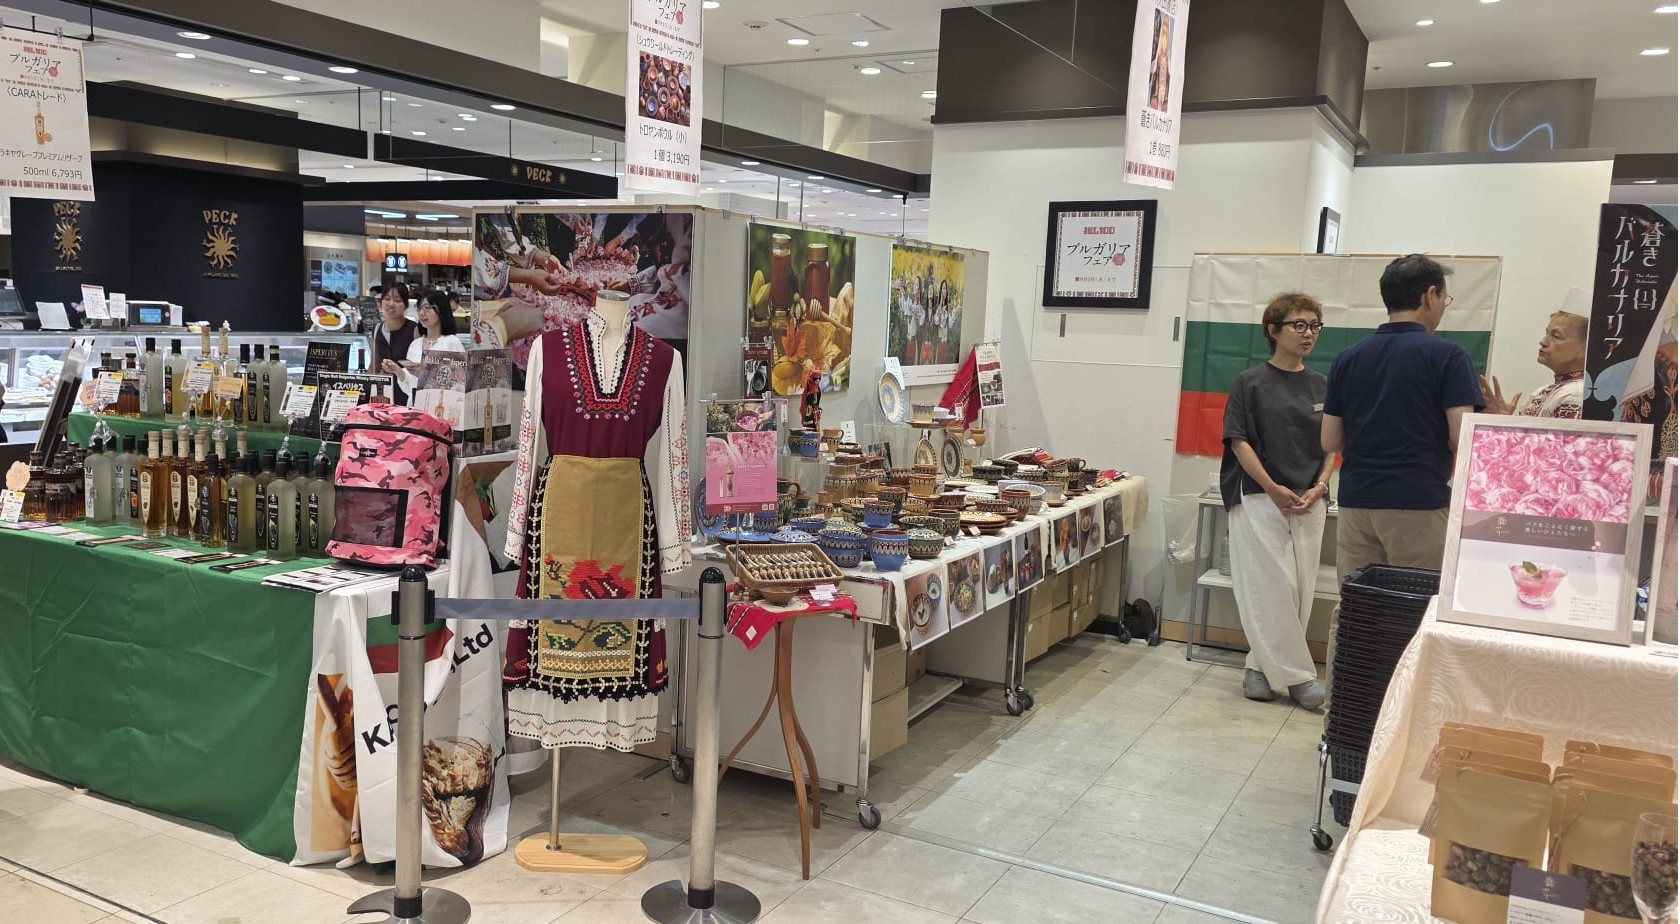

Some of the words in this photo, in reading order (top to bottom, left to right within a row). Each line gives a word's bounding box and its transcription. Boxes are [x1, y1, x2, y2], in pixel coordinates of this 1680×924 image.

[659, 7, 676, 21] フェア
[10, 53, 61, 68] ブルガリア
[24, 65, 50, 76] フェア
[23, 166, 49, 176] 500ml
[51, 169, 82, 179] 6,793円
[525, 166, 553, 183] PECK
[53, 201, 81, 217] PECK
[203, 209, 239, 226] PECK
[1067, 242, 1131, 256] ブルガリア
[1640, 221, 1666, 267] 蒼き
[1083, 256, 1113, 266] フェア
[1604, 216, 1636, 360] バルカナリア
